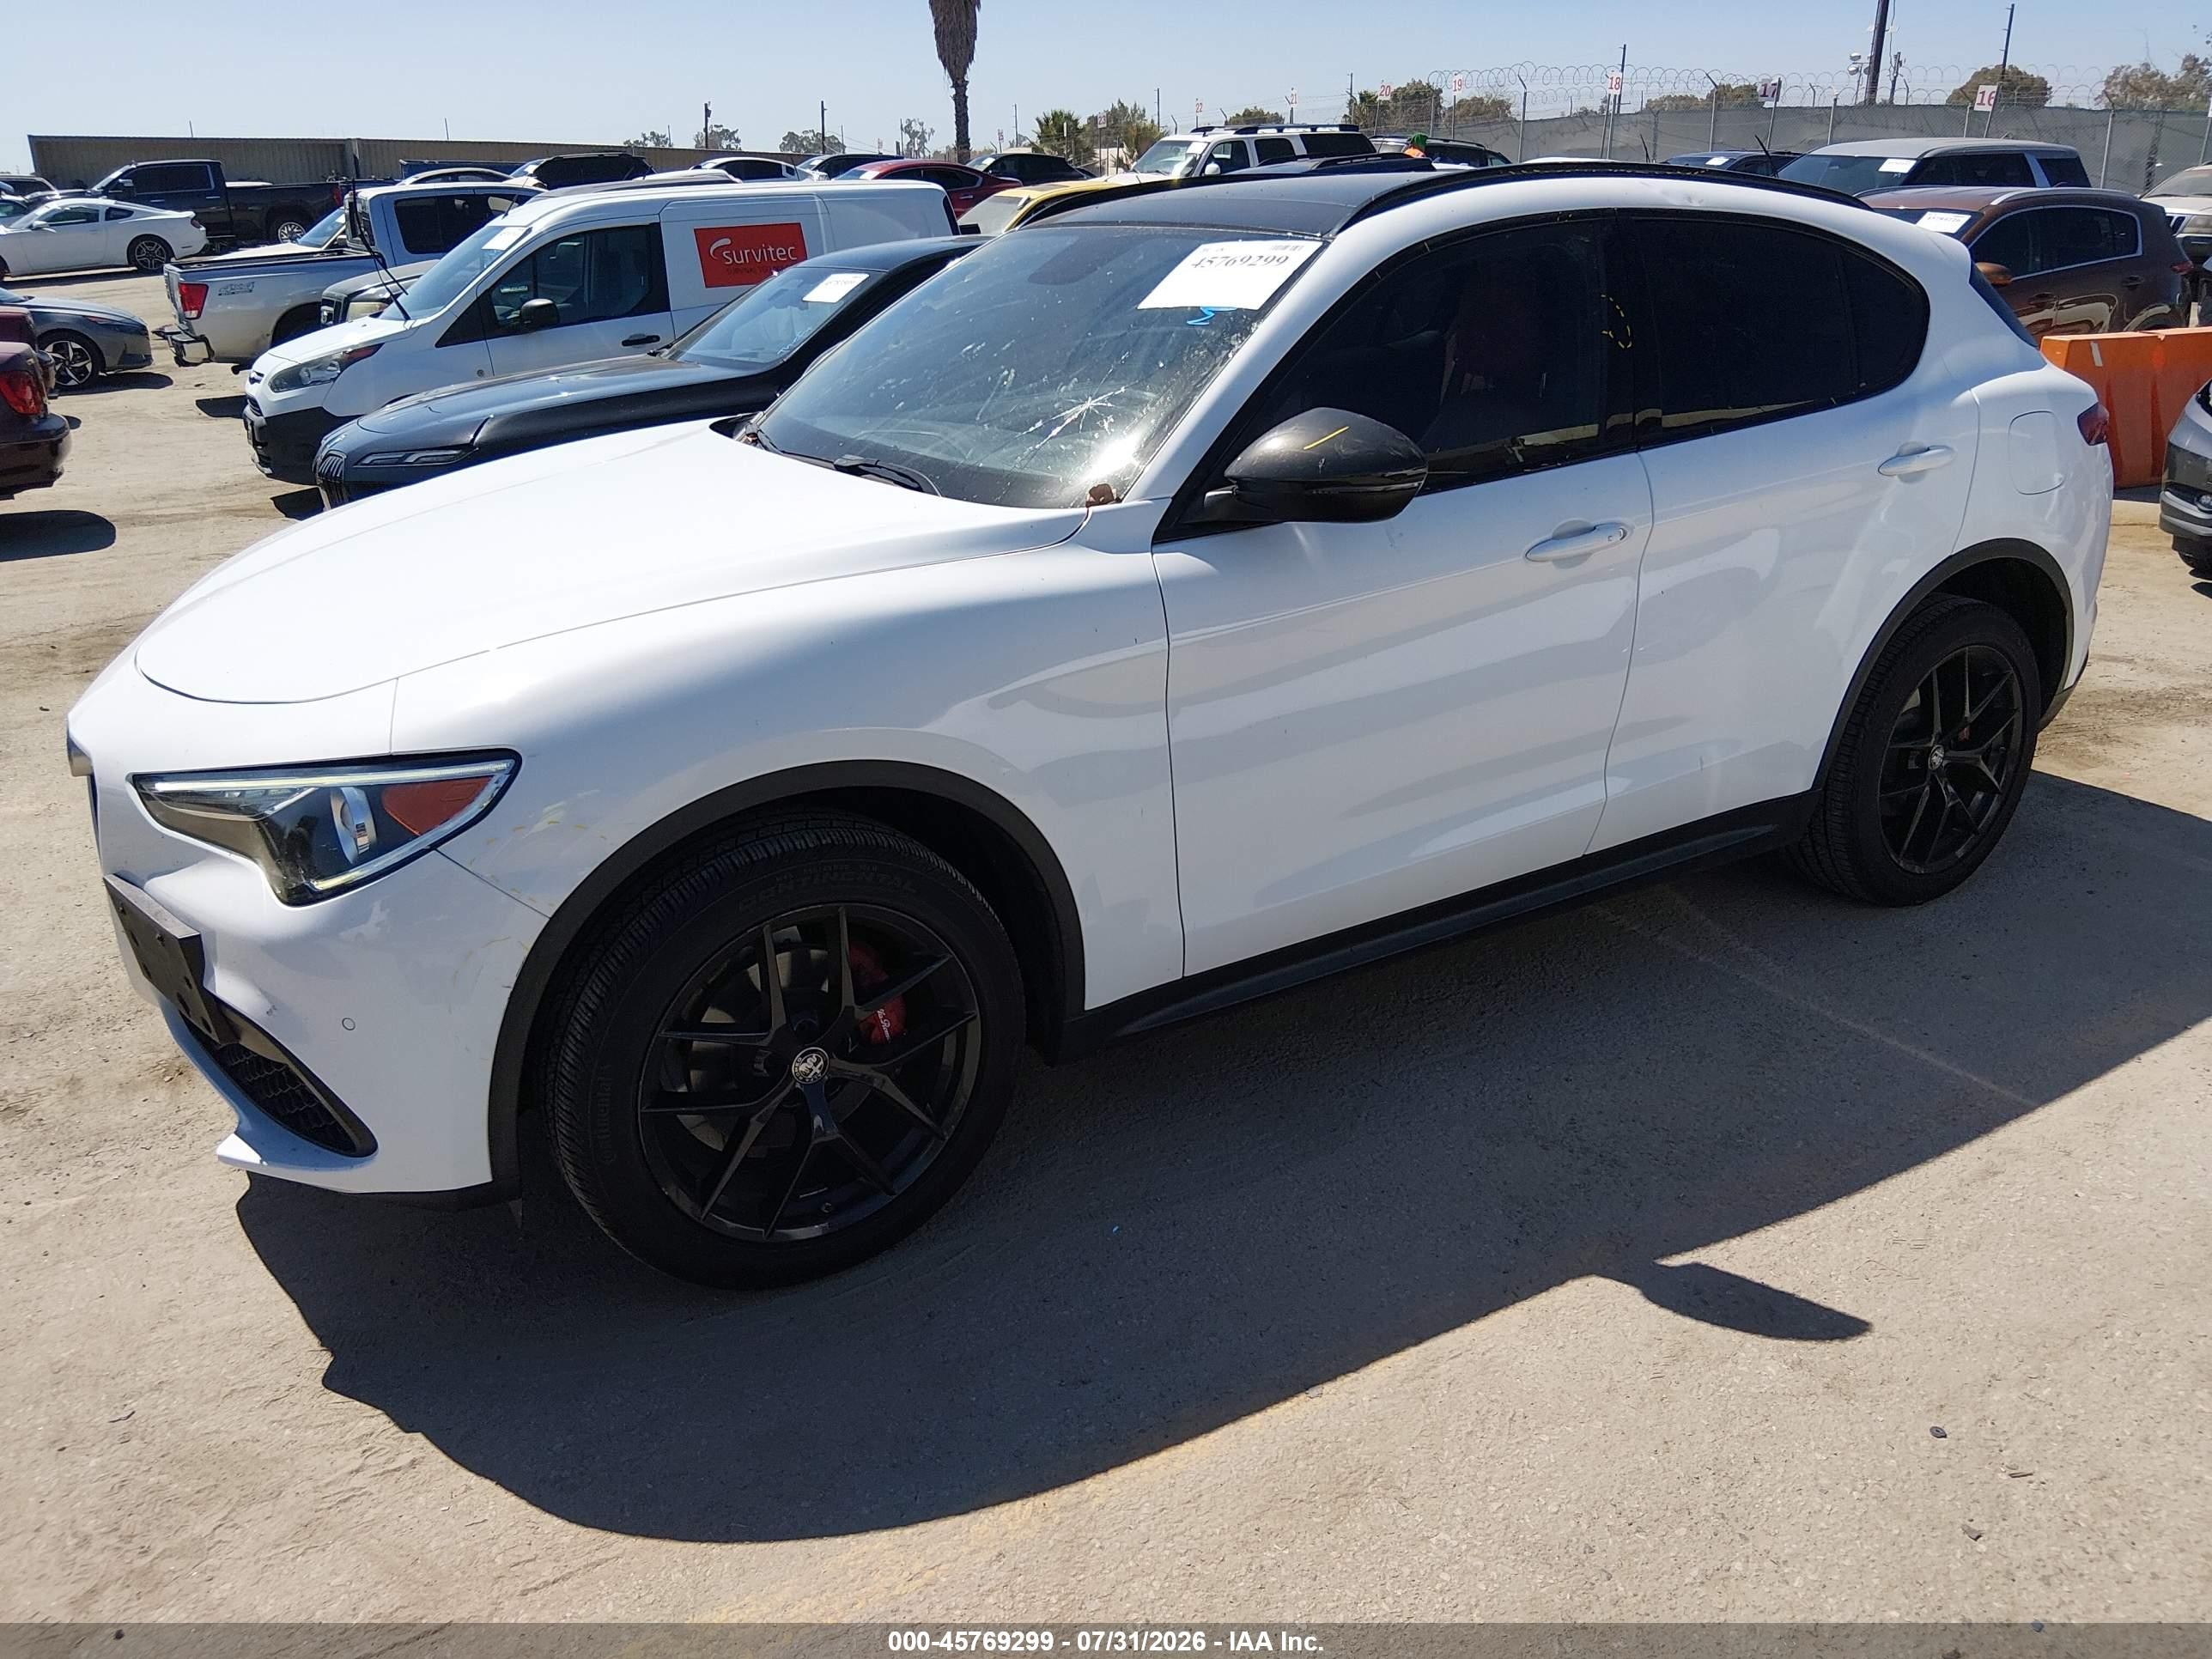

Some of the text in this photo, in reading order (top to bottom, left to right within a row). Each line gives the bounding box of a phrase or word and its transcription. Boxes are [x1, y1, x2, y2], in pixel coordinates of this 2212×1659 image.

[1452, 78, 1462, 92] 19
[1608, 76, 1621, 90] 18
[1759, 82, 1778, 98] 17
[1378, 85, 1391, 97] 20
[1977, 89, 1996, 106] 16
[1291, 94, 1297, 105] 21
[1195, 102, 1203, 113] 22
[1098, 116, 1106, 125] 23
[722, 243, 798, 265] survitec
[1191, 254, 1290, 268] 45769299
